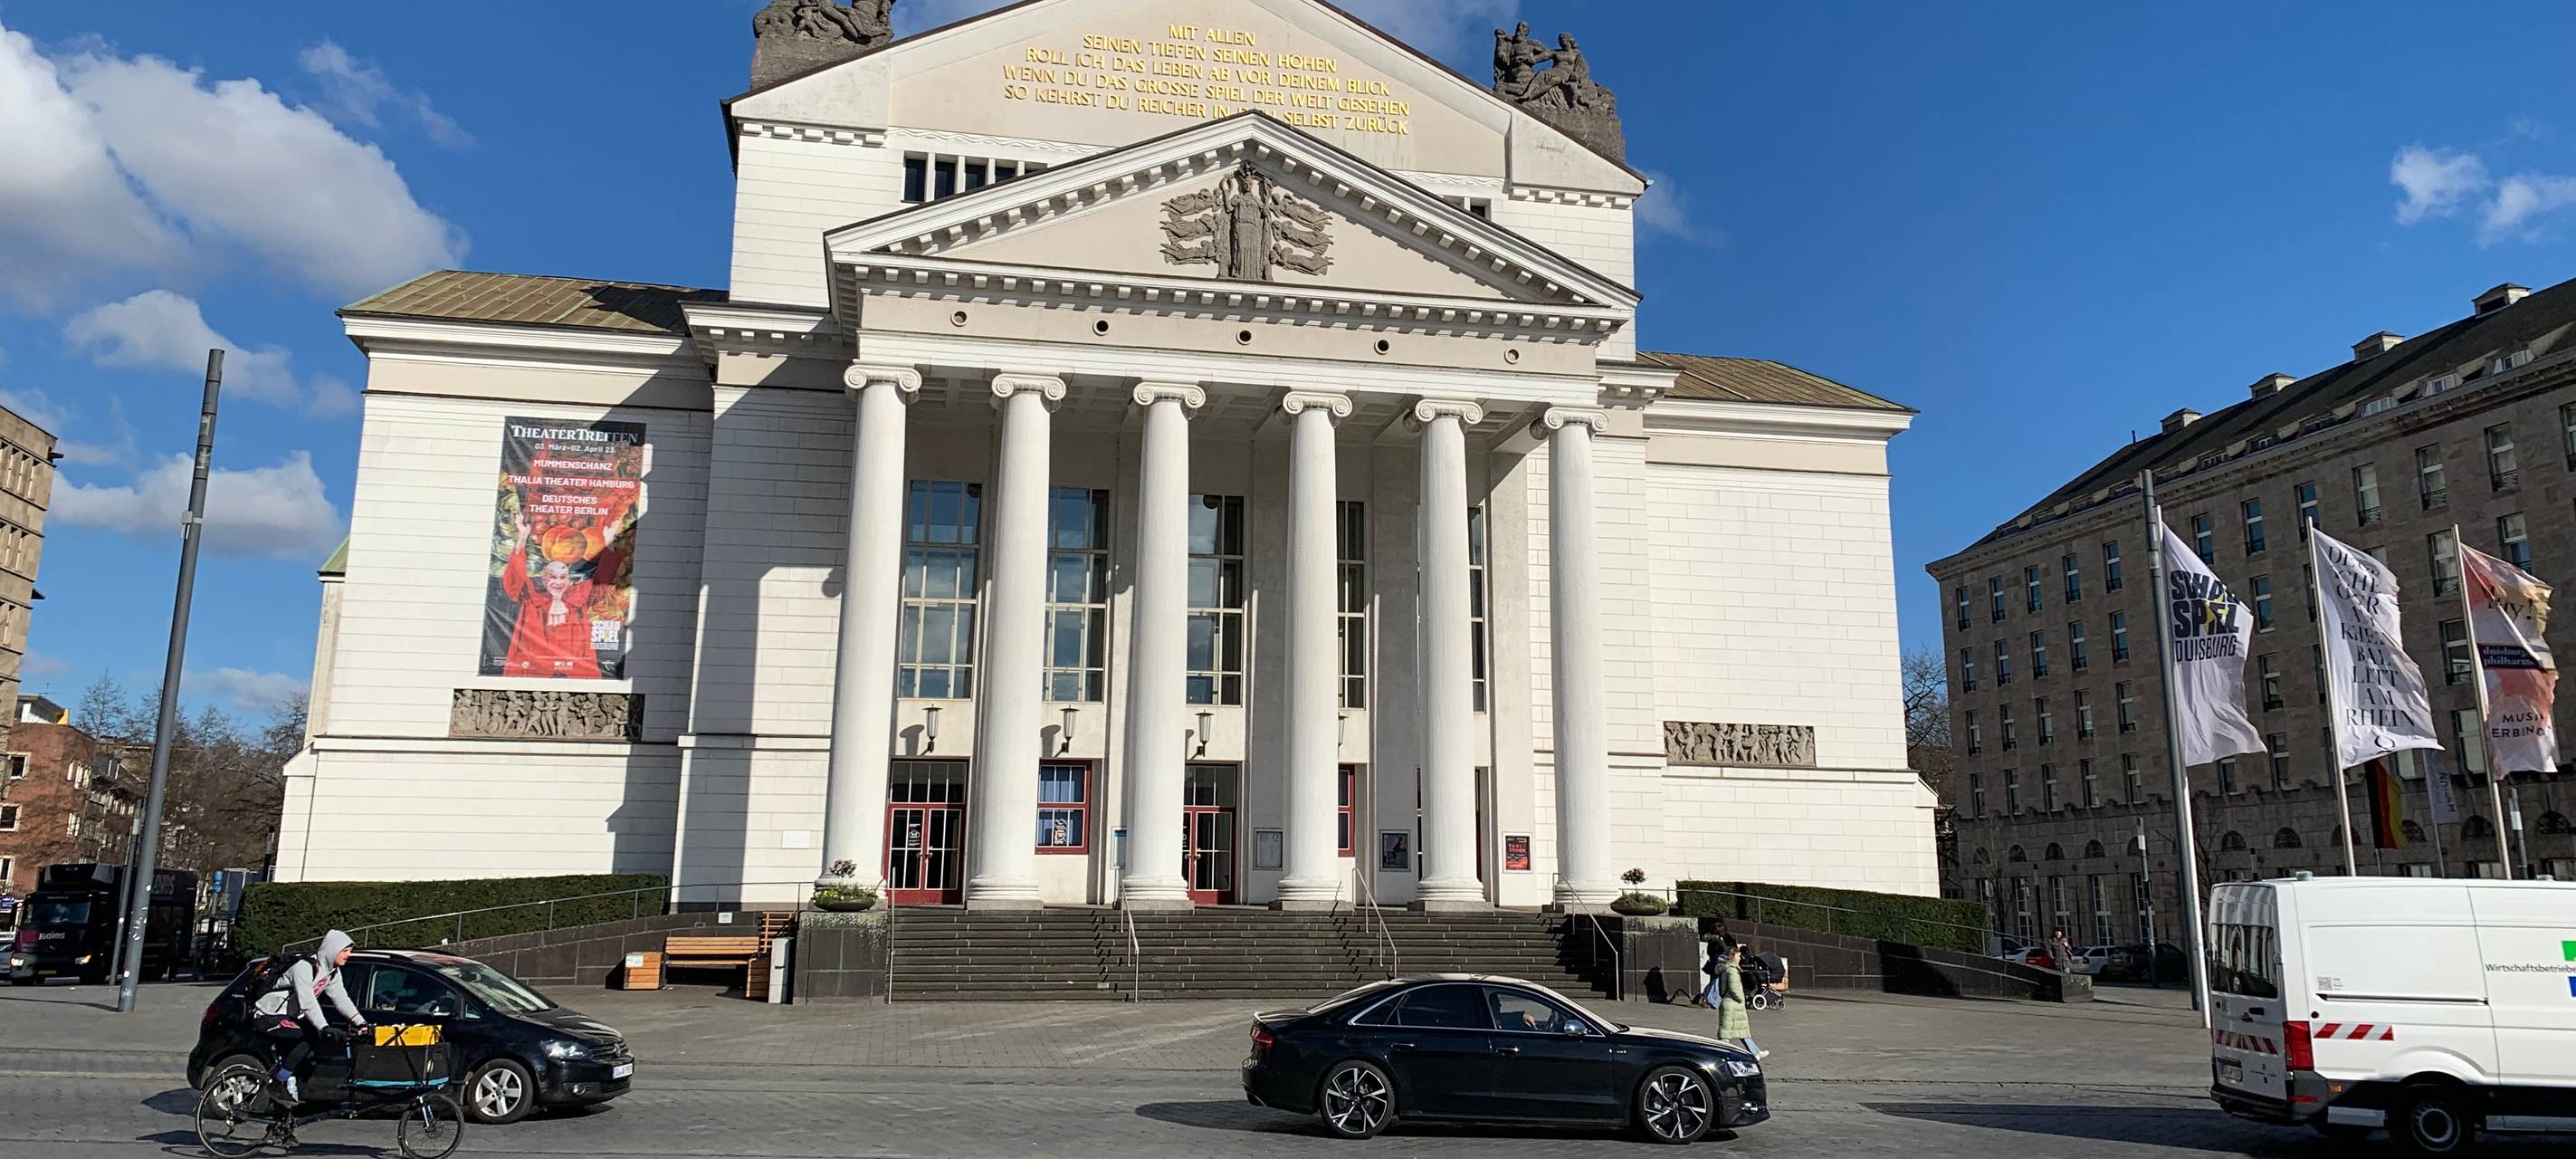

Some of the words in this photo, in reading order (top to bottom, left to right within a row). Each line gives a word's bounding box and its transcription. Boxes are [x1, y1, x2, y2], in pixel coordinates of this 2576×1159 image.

[1169, 24, 1197, 40] MIT
[1206, 28, 1255, 46] ALLEN
[1083, 34, 1142, 54] SEINEN
[1148, 42, 1207, 61] TIEFEN
[1213, 48, 1270, 67] SEINEN
[1026, 47, 1069, 66] ROLL
[1075, 53, 1105, 69] ICH
[1112, 56, 1146, 73] DAS
[1152, 61, 1203, 80] LEBEN
[1208, 66, 1230, 81] AB
[1236, 69, 1272, 86] VOR
[1278, 72, 1340, 91] DEINEM
[1347, 79, 1391, 97] BLICK
[1003, 64, 1056, 83] WENN
[1064, 71, 1088, 86] DU
[1095, 73, 1128, 90] DAS
[1134, 79, 1198, 99] GROSSE
[1205, 85, 1247, 102] SPIEL
[1253, 89, 1284, 106] DER
[1290, 92, 1332, 110] WELT
[1338, 97, 1410, 117] GESEHEN
[1005, 84, 1029, 100] SO
[1035, 87, 1101, 108] KEHRST
[1106, 94, 1131, 110] DU
[1138, 97, 1207, 119] REICHER
[1283, 110, 1339, 130] SELBST
[1344, 115, 1407, 135] ZURÜCK
[533, 459, 613, 471] MUMMENSCHANZ
[508, 474, 542, 485] THALIA
[544, 476, 588, 487] THEATER
[588, 478, 635, 489] HAMBURG
[542, 494, 597, 505] DEUTSCHES
[530, 503, 573, 514] THEATER
[574, 505, 609, 516] BERLIN
[2175, 636, 2237, 662] DUISBURG
[2357, 647, 2391, 666] BAL
[2363, 688, 2395, 704] AM
[2346, 708, 2415, 726] RHEIN
